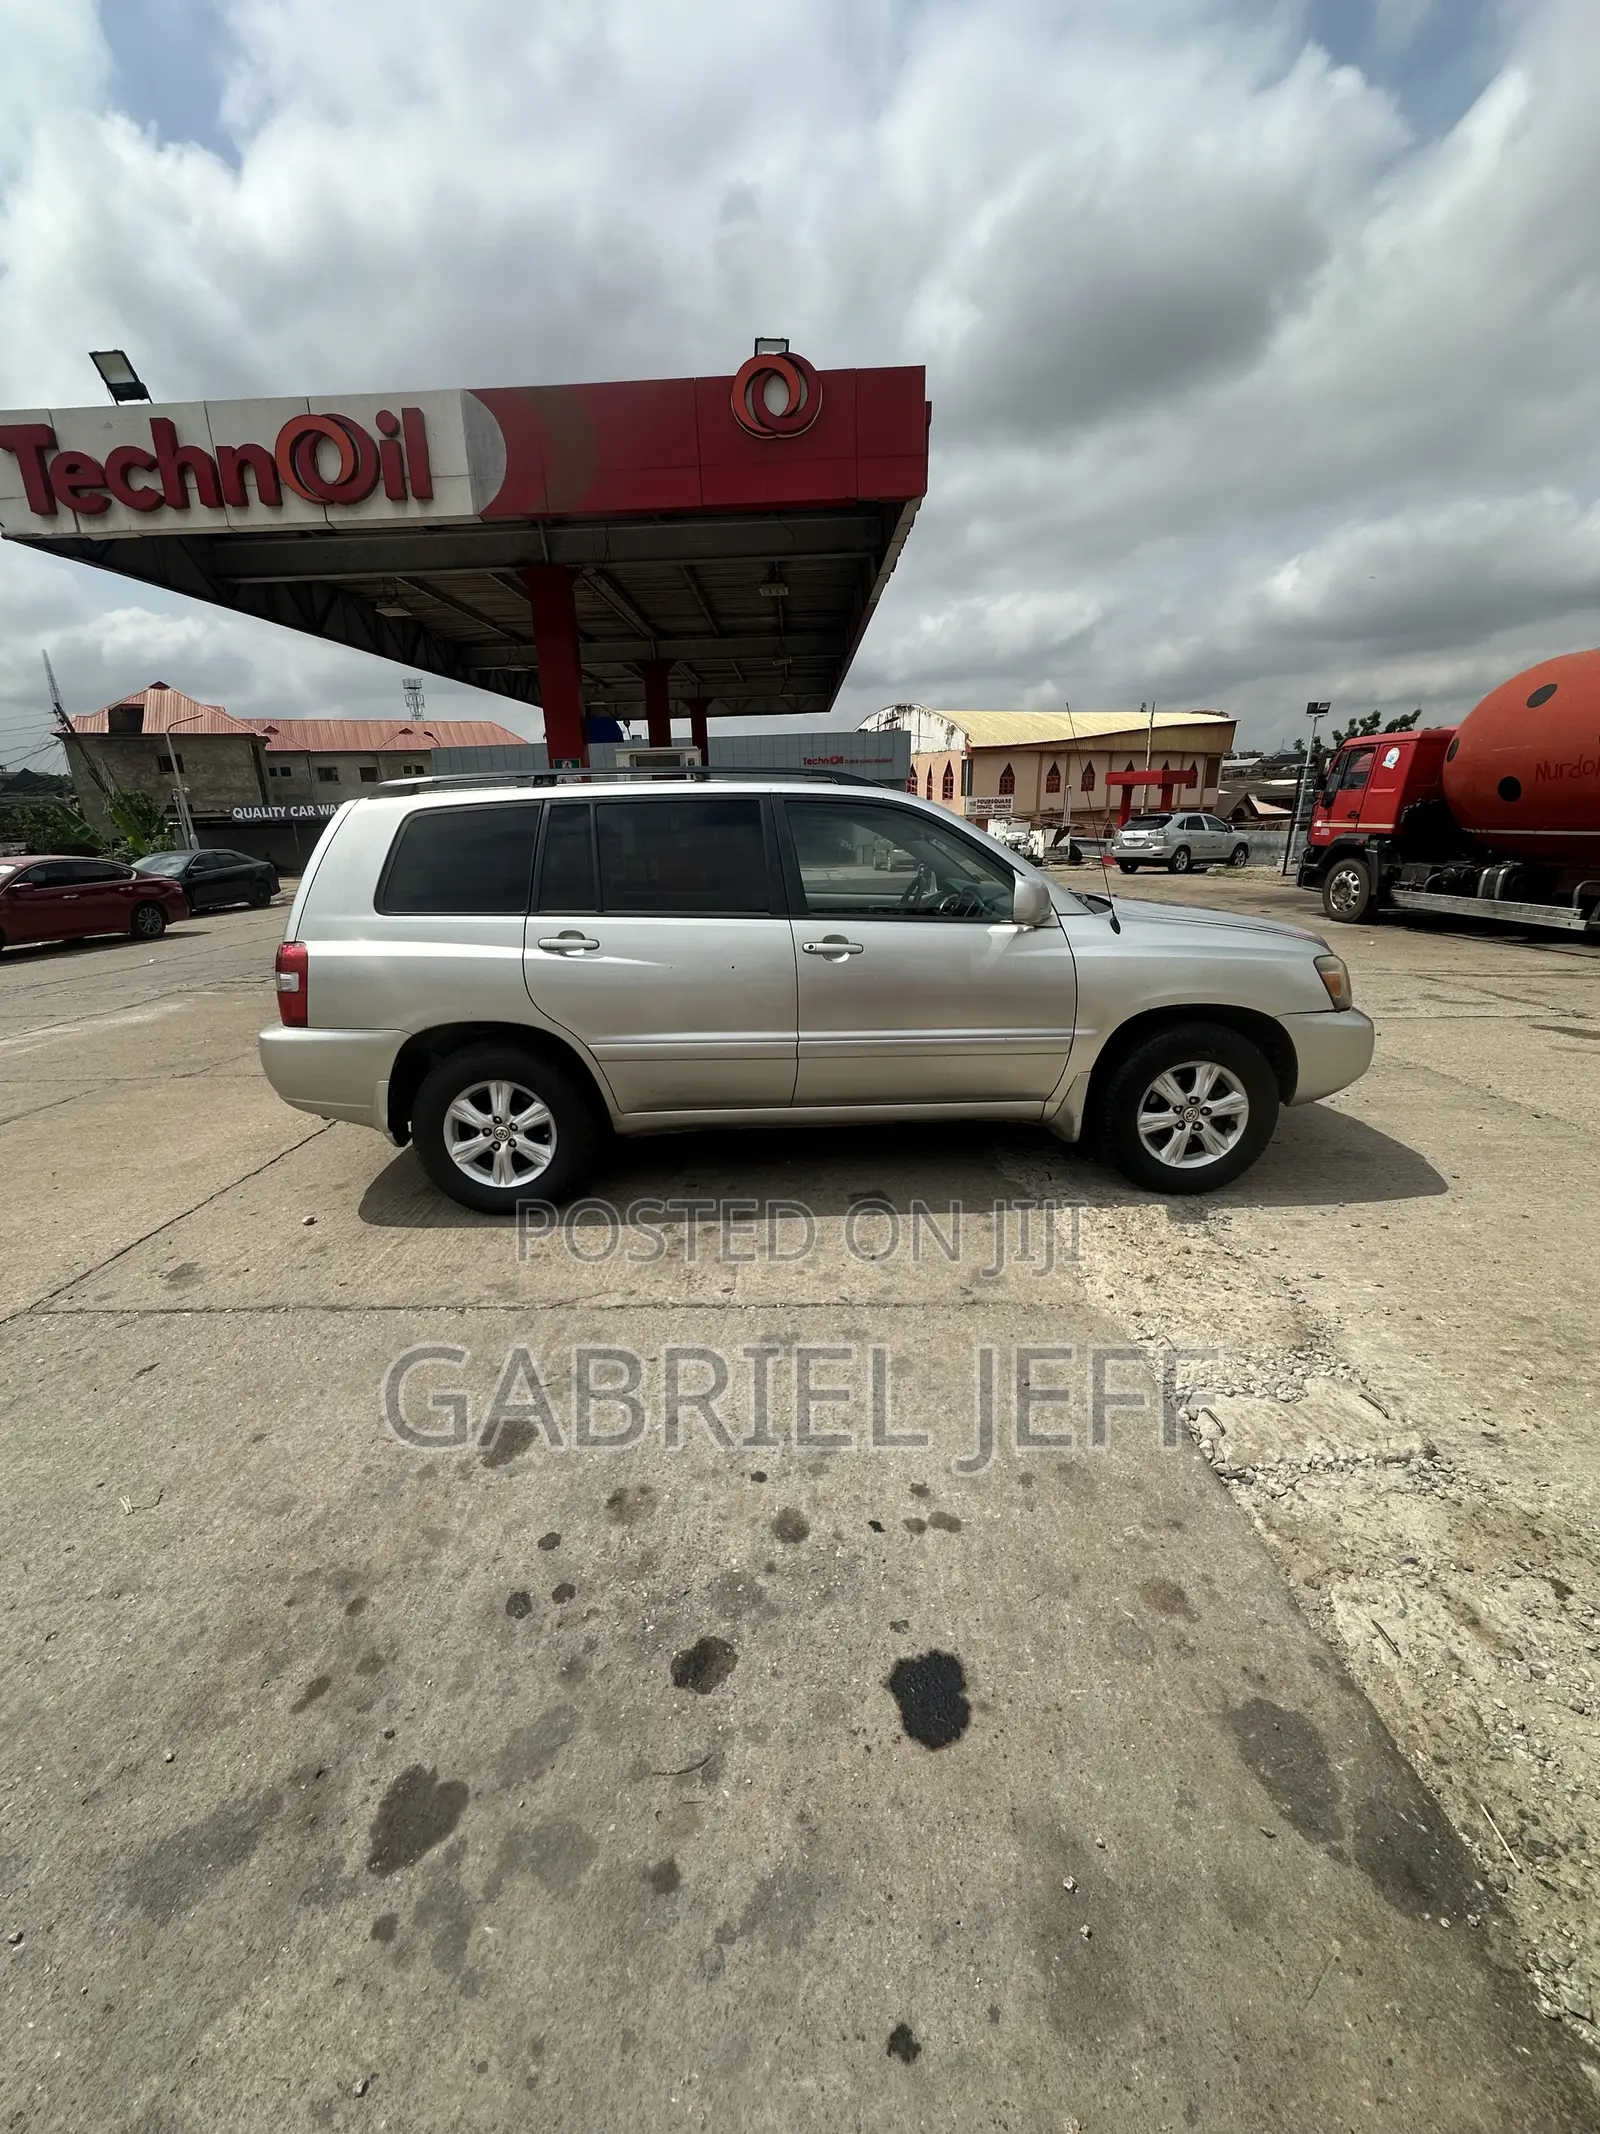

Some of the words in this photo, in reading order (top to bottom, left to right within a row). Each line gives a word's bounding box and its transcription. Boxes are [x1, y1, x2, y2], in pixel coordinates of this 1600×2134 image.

[0, 407, 434, 516] TechnOil
[232, 807, 286, 819] QUALITY
[290, 805, 316, 817] CAR
